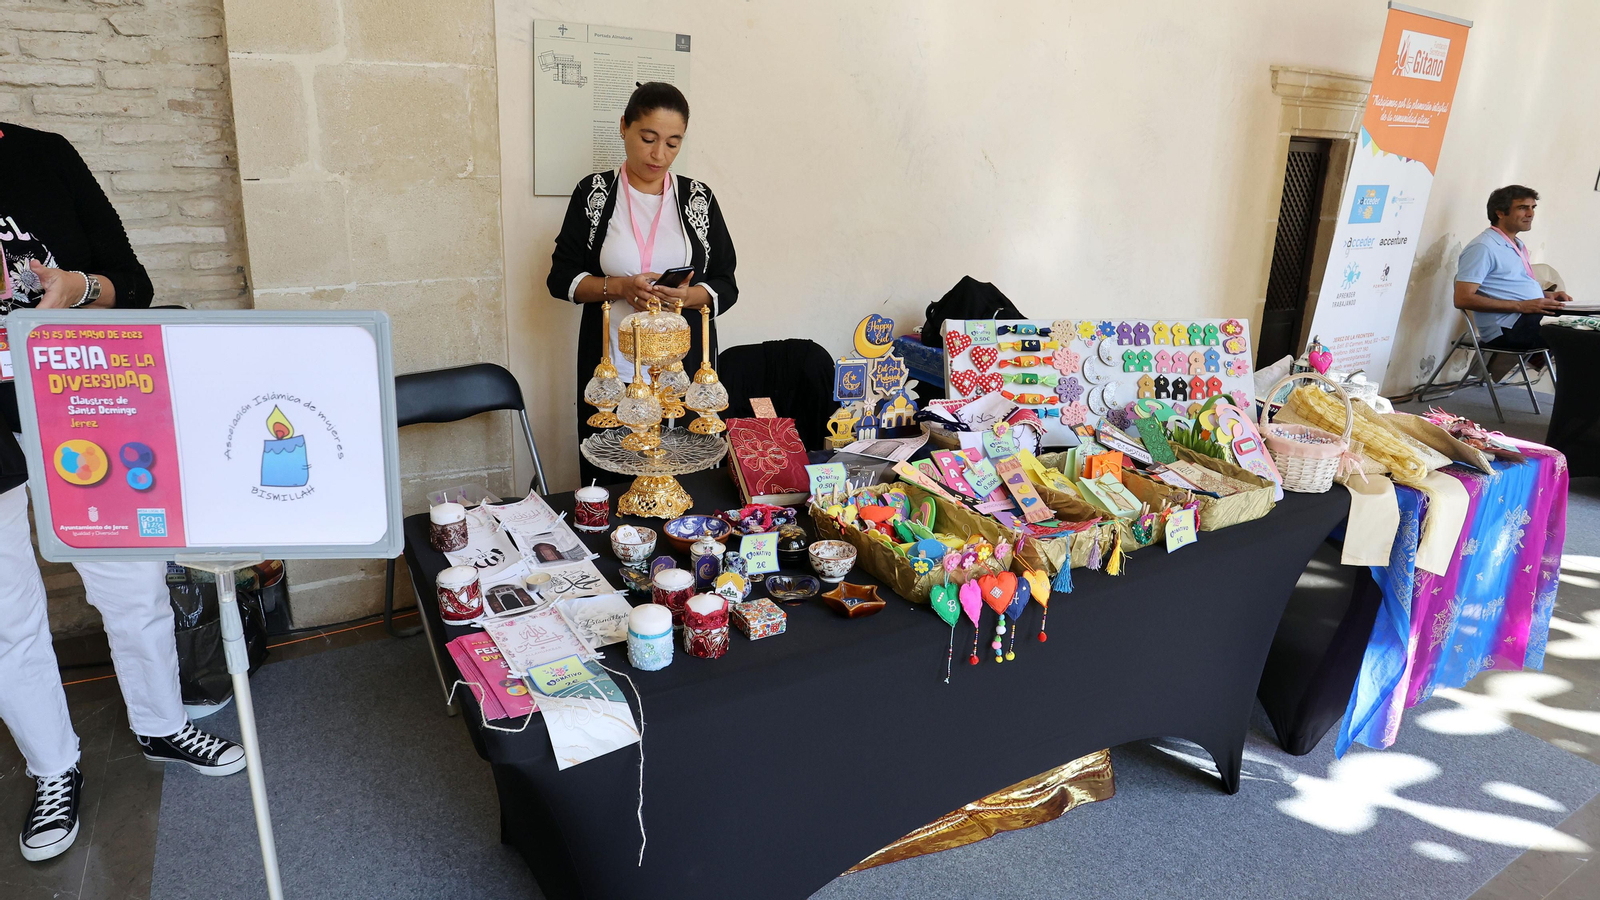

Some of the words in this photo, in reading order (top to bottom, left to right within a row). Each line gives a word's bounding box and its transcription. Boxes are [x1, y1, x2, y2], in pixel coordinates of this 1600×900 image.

[1413, 50, 1444, 77] Gitano
[1336, 291, 1356, 299] APRENDER
[1332, 299, 1356, 308] TRABAJANDO
[867, 321, 892, 334] Happy
[30, 330, 40, 339] 24
[42, 330, 50, 339] Y
[52, 330, 63, 339] 25
[65, 330, 78, 339] DE
[79, 330, 106, 339] MAYO
[108, 330, 120, 339] DE
[121, 331, 143, 339] 2023
[875, 330, 889, 344] Eid
[33, 345, 108, 370] FERIA
[110, 354, 131, 367] DE
[135, 354, 155, 367] LA
[48, 370, 154, 394] DIVERSIDAD
[70, 395, 114, 405] Claustros
[116, 395, 128, 405] de
[68, 405, 96, 415] Santo
[98, 405, 137, 416] Domingo
[70, 418, 99, 428] Jerez
[224, 403, 252, 461] Asociación
[252, 391, 301, 407] Islámica
[303, 401, 316, 411] de
[317, 411, 344, 460] mujeres
[251, 485, 315, 501] BISMILLAH
[746, 551, 772, 560] DONATIVO
[756, 561, 766, 569] 2€
[546, 672, 582, 686] DONATIVO
